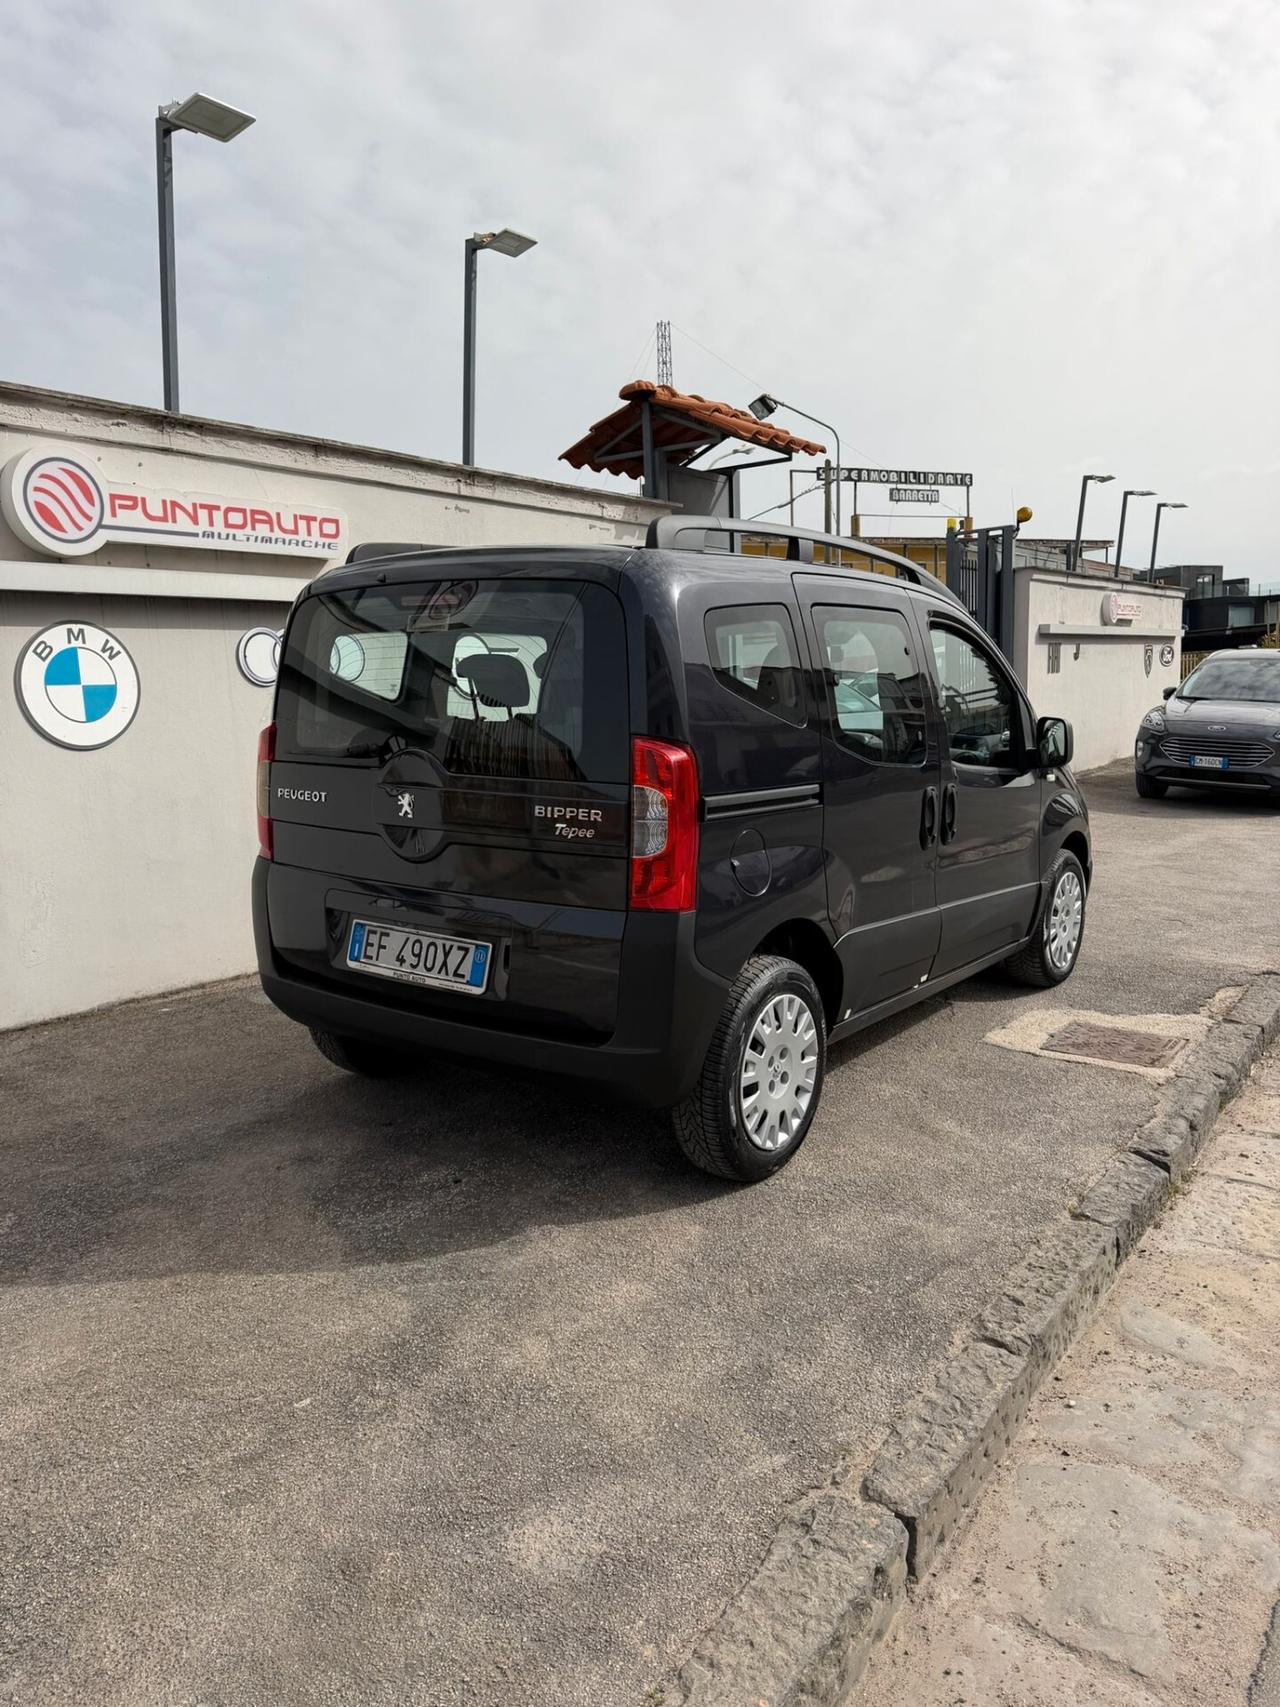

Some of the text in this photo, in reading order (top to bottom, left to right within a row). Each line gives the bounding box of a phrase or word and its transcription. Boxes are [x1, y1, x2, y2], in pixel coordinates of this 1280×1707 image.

[892, 489, 939, 502] BARRETTA
[109, 493, 340, 539] PUNTOAUTO
[201, 530, 339, 551] MULTIMARCHE
[32, 627, 121, 662] BMW
[277, 787, 328, 803] PEUGEOT
[534, 805, 603, 822] BIPPER
[554, 823, 596, 839] Tepee
[363, 929, 390, 961] EF
[395, 936, 471, 979] 490XZ
